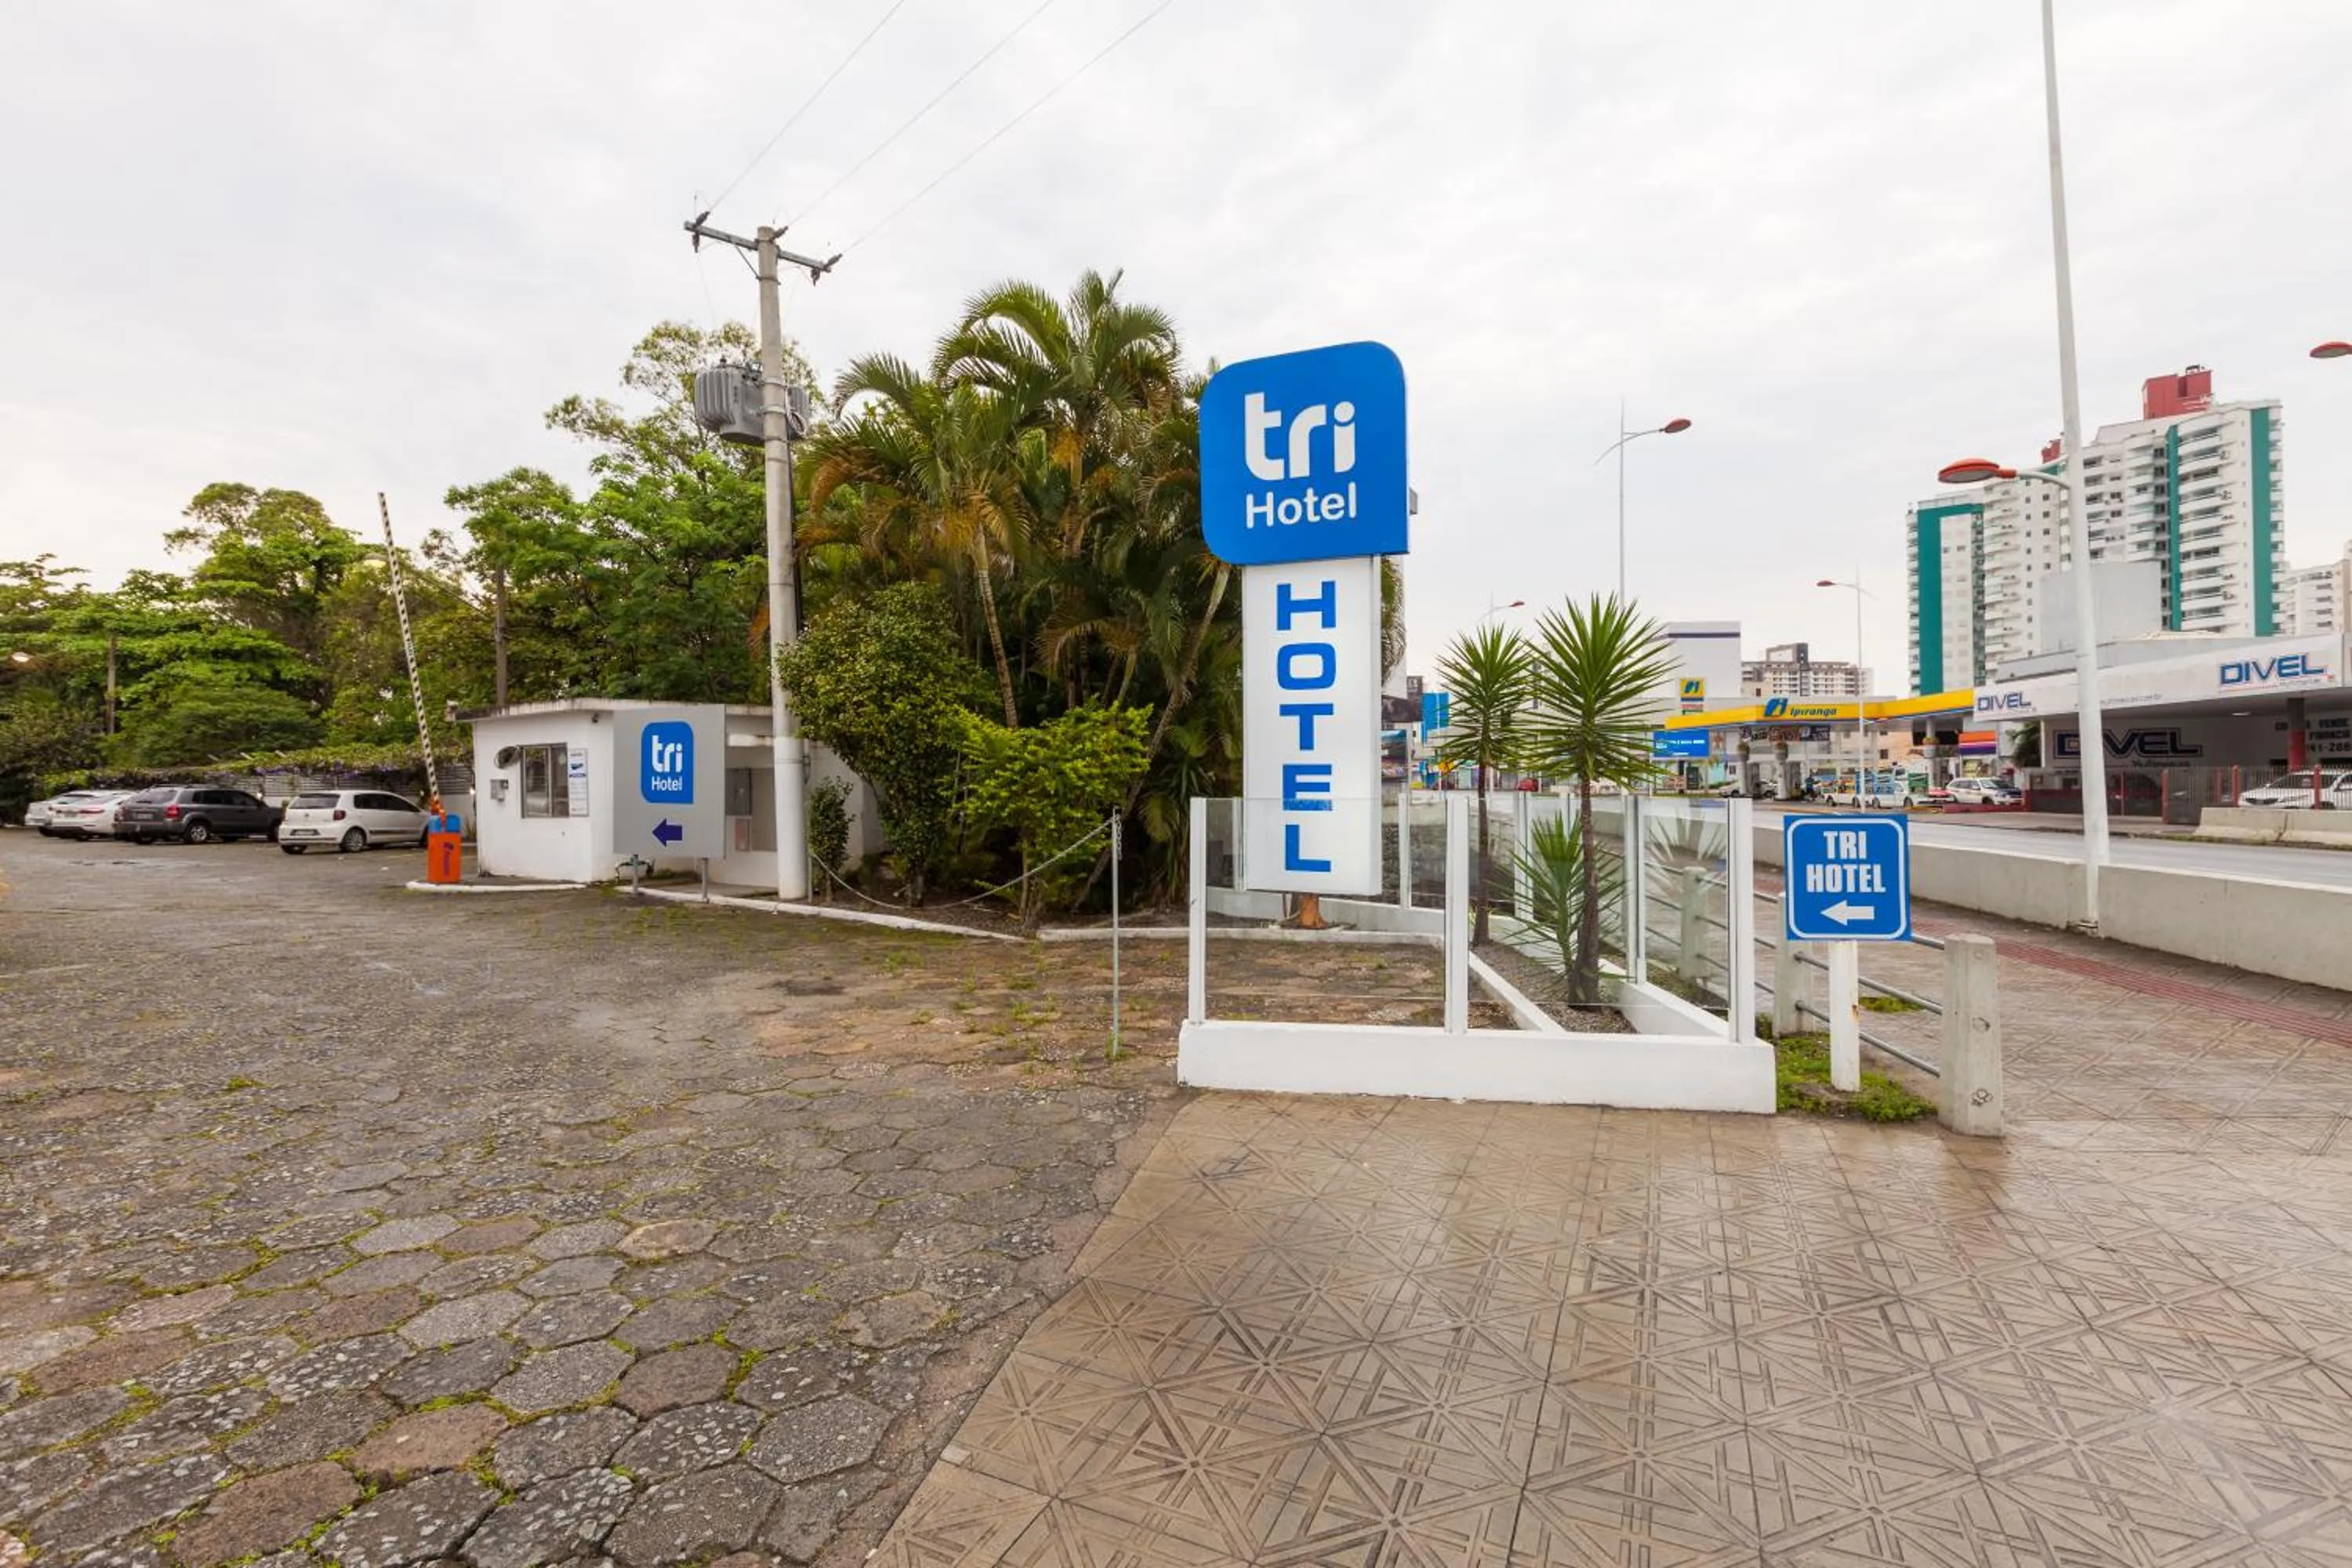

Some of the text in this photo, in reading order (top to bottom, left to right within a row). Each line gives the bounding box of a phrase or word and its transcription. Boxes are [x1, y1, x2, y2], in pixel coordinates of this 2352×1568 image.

[1244, 391, 1356, 481] tri
[1246, 481, 1357, 529] Hotel
[2220, 652, 2325, 684] DIVEL
[1791, 706, 1837, 717] Ipiranga
[1977, 691, 2032, 711] DIVEL
[1276, 580, 1336, 873] HOTEL
[652, 735, 683, 773] tri
[2055, 728, 2201, 759] DVEL
[652, 775, 683, 791] Hotel
[1823, 830, 1867, 860] TRI
[1806, 863, 1887, 893] HOTEL
